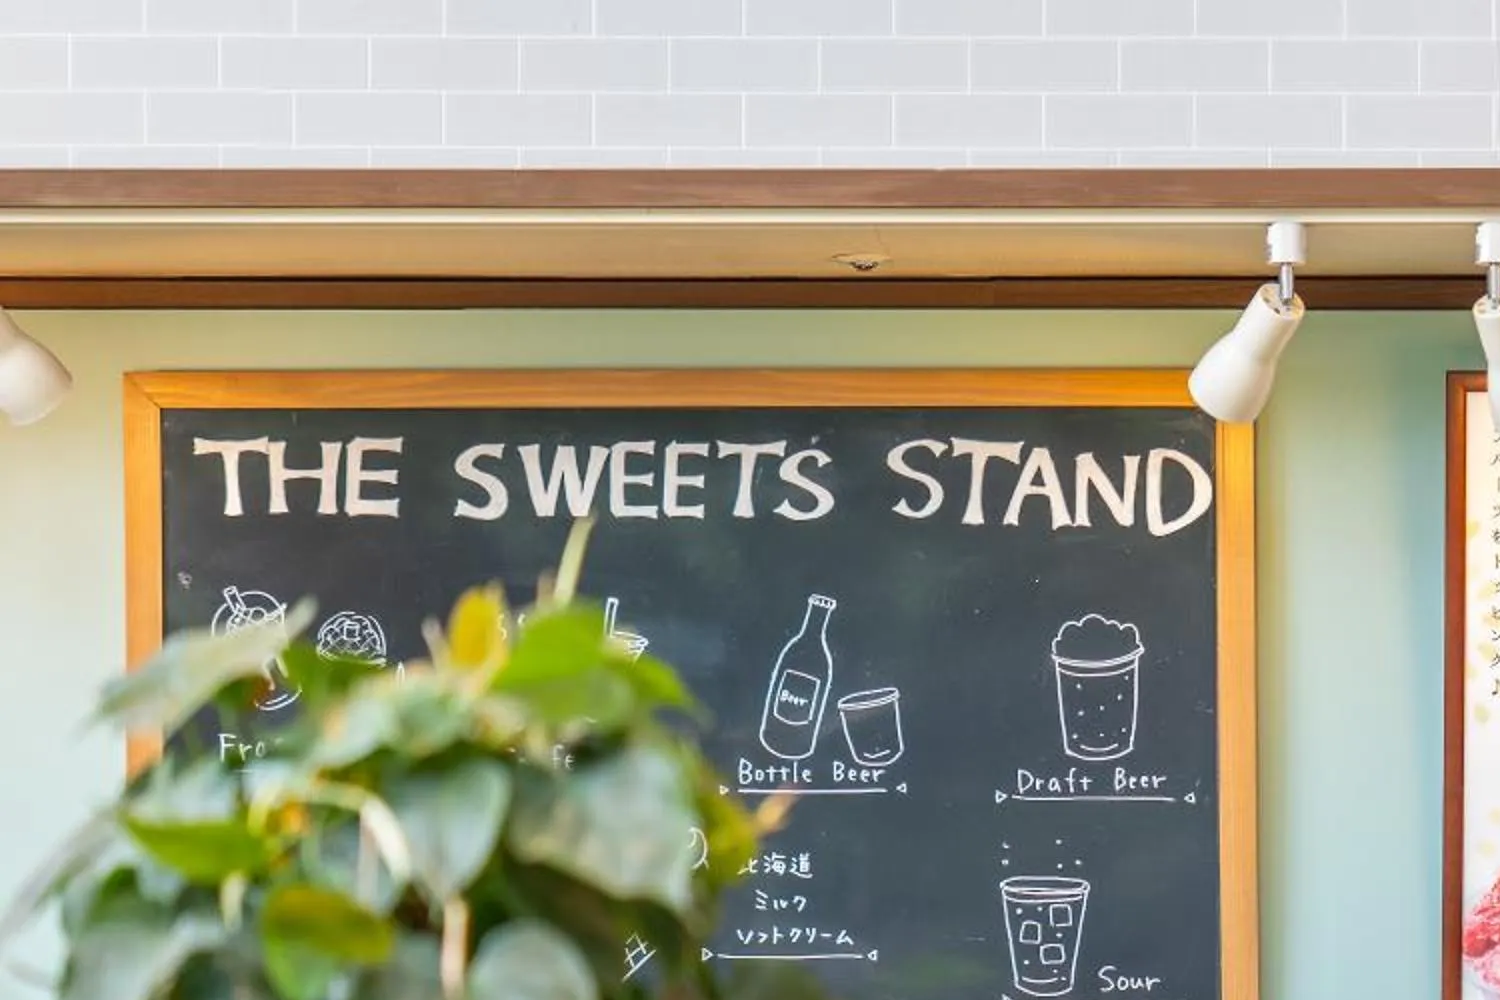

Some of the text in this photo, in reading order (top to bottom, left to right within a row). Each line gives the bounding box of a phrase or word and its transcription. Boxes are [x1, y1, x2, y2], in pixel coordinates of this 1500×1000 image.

[193, 436, 1214, 538] THE SWEETS STAND
[737, 757, 887, 785] Bottle Beer
[1016, 769, 1167, 794] Draft Beer
[755, 888, 807, 913] ミルク
[1098, 967, 1161, 993] Sour
